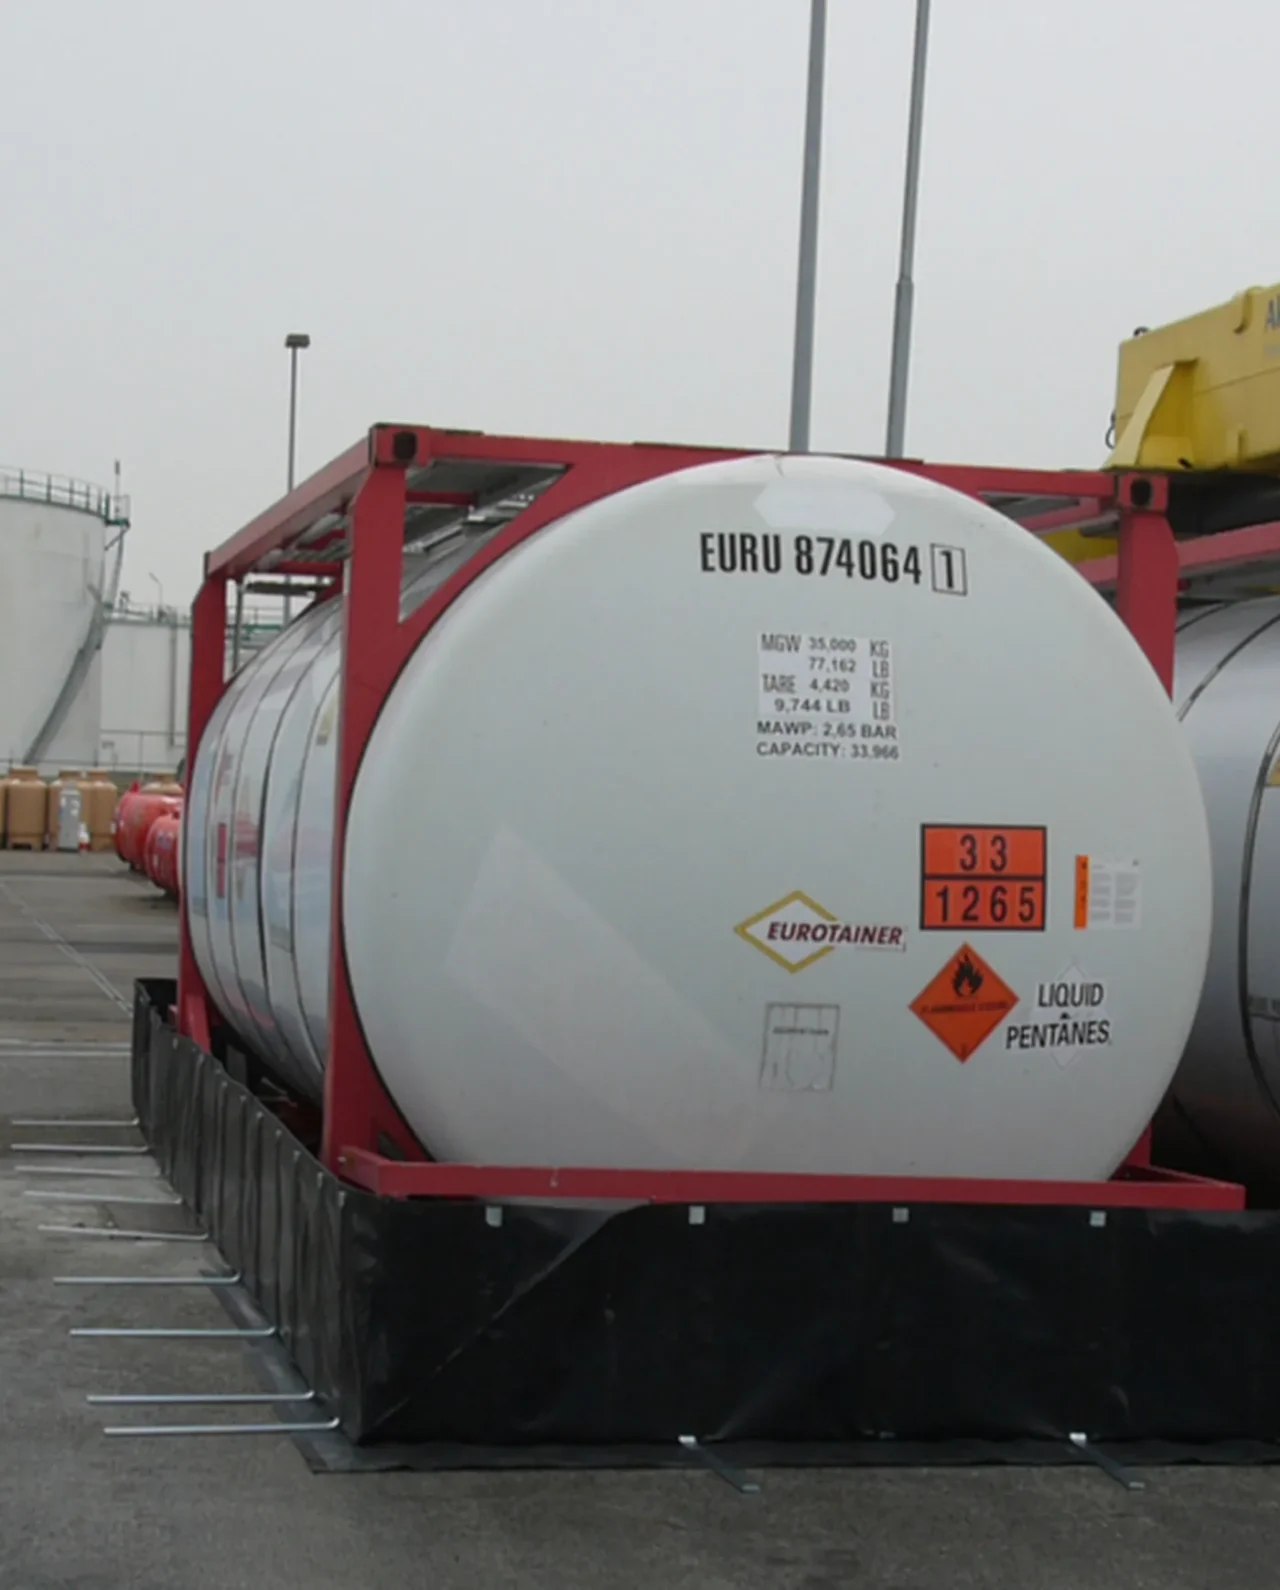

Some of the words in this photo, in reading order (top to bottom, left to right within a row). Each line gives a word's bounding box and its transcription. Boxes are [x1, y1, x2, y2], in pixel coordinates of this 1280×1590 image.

[700, 532, 782, 573] EURU
[794, 534, 922, 586] 874064
[939, 549, 954, 590] 1
[761, 633, 802, 653] MGW
[869, 639, 889, 658] KG
[872, 660, 890, 678] LB
[762, 673, 796, 694] TARE
[869, 681, 890, 700] KG
[826, 699, 851, 713] LB
[872, 701, 890, 721] LB
[860, 724, 898, 740] BAR
[756, 741, 846, 757] CAPACITY:
[937, 885, 1036, 923] 1265
[767, 922, 904, 945] EUROTAINER
[1038, 982, 1104, 1008] LIQUID
[1005, 1019, 1111, 1050] PENTANES
